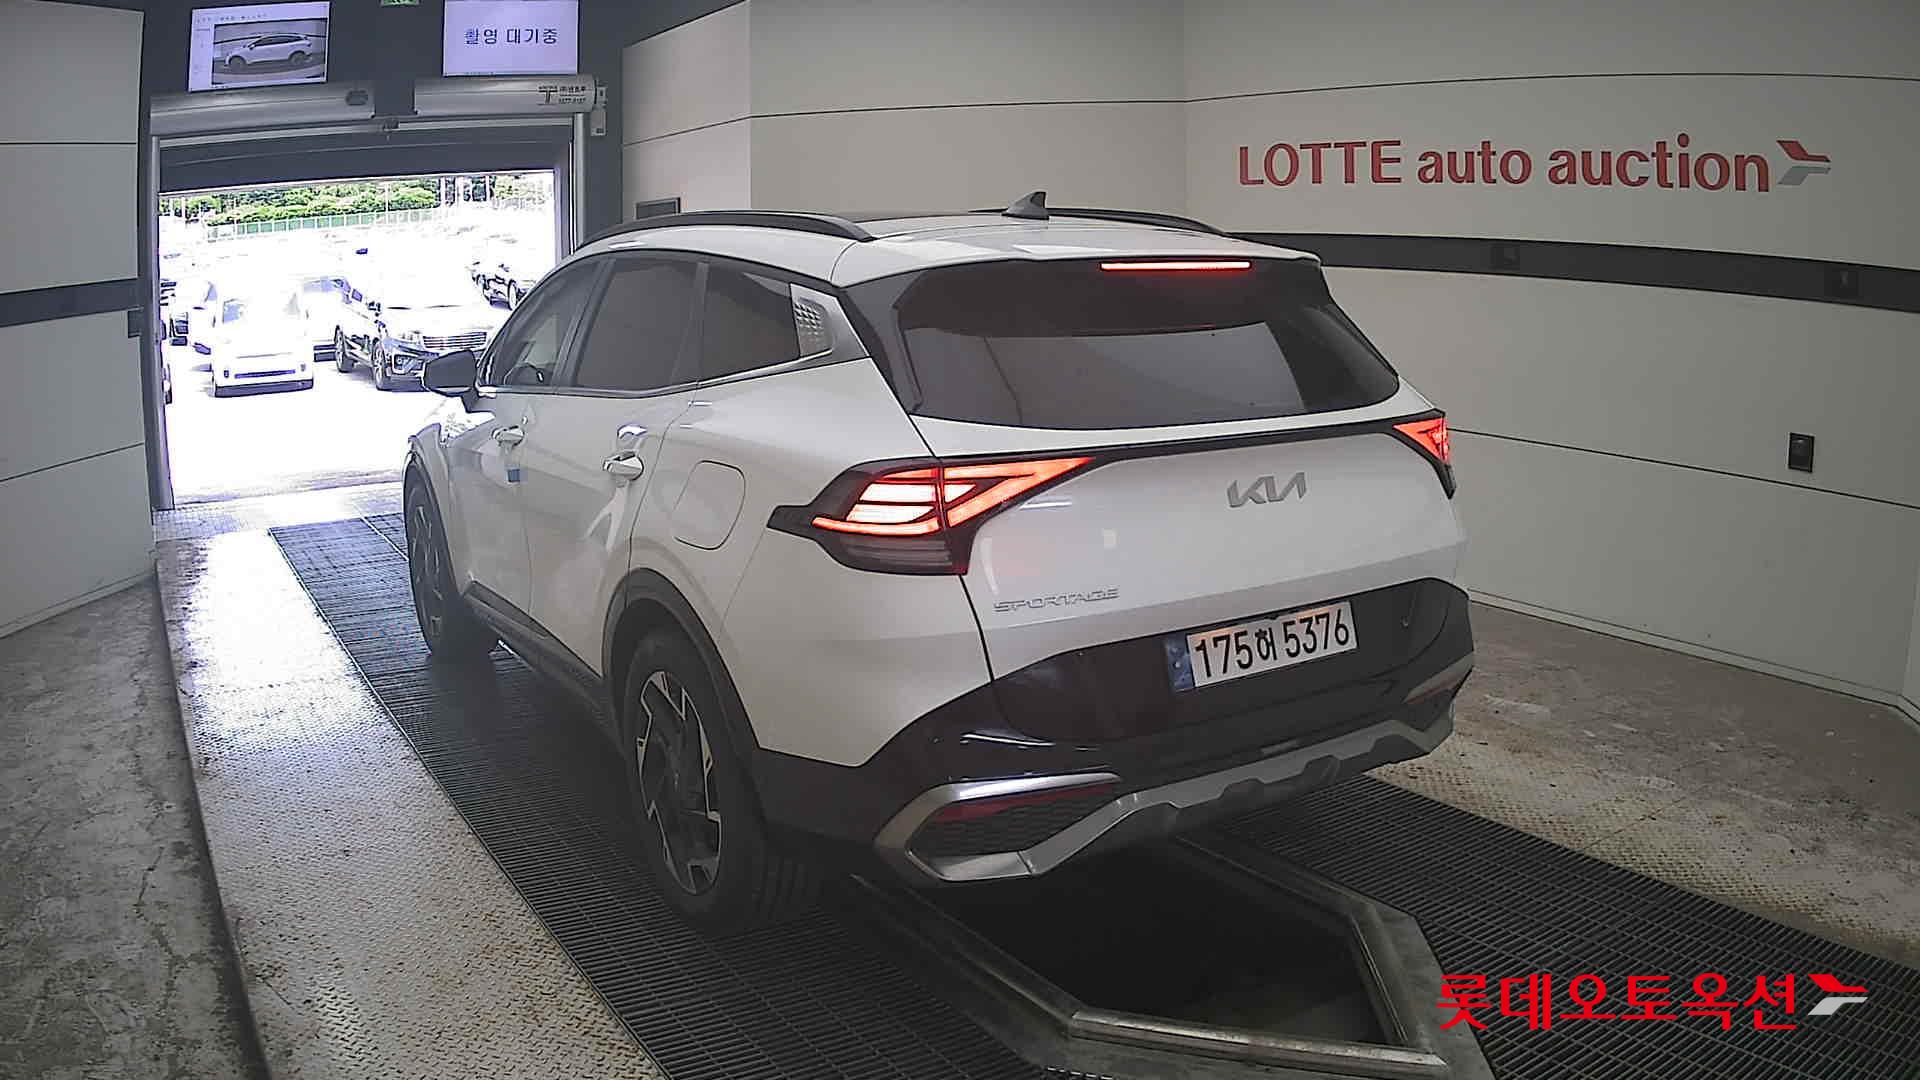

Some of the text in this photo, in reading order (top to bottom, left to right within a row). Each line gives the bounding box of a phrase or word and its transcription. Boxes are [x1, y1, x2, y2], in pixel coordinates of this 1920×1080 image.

[505, 27, 558, 45] 대기중
[1238, 132, 1771, 193] LOTTE auto auction
[993, 588, 1121, 613] SPORTAGE
[1281, 607, 1350, 658] 5376
